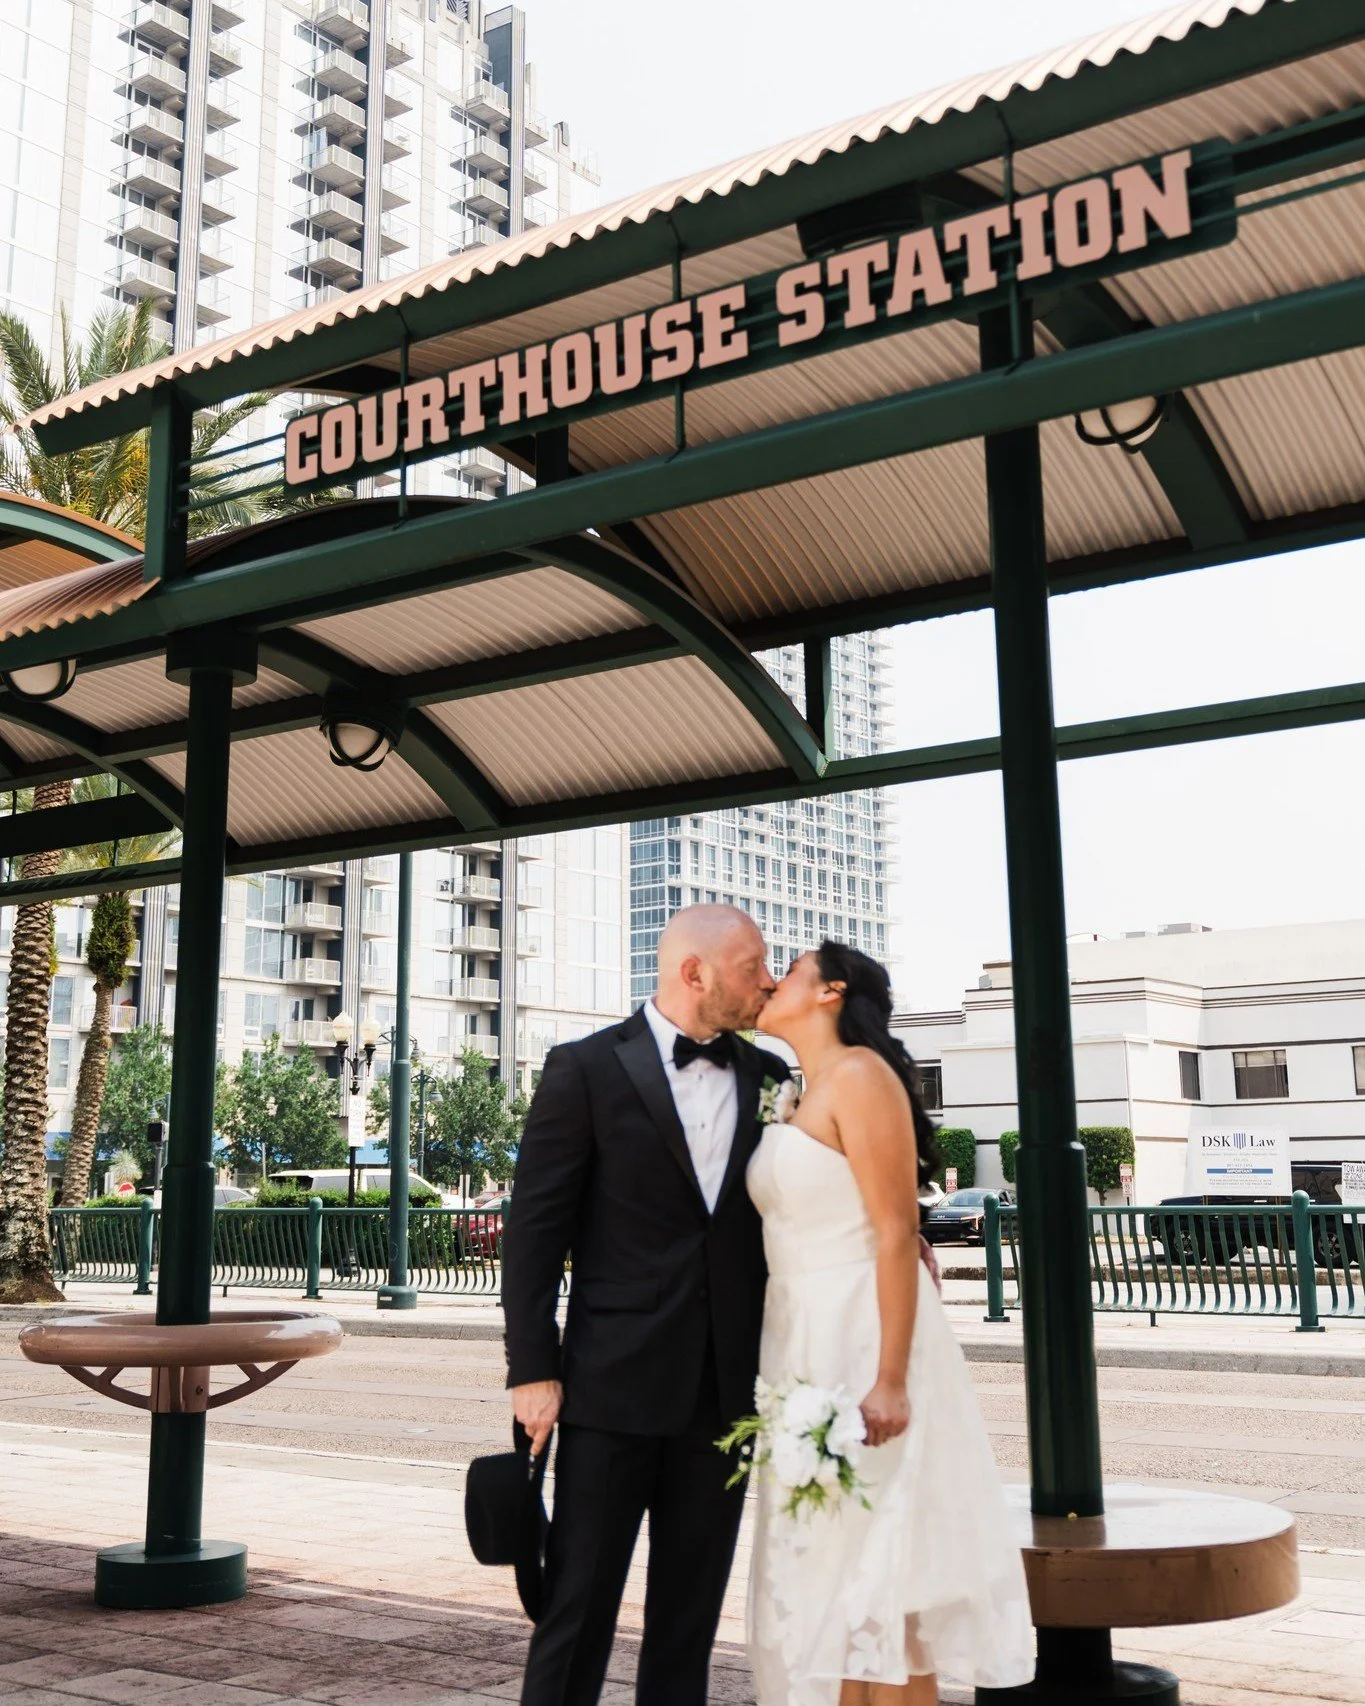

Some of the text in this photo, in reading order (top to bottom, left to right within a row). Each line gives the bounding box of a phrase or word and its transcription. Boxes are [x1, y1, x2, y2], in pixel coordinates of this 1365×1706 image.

[285, 151, 1193, 485] COURTHOUSE STATION
[1201, 1135, 1276, 1148] DSK Law
